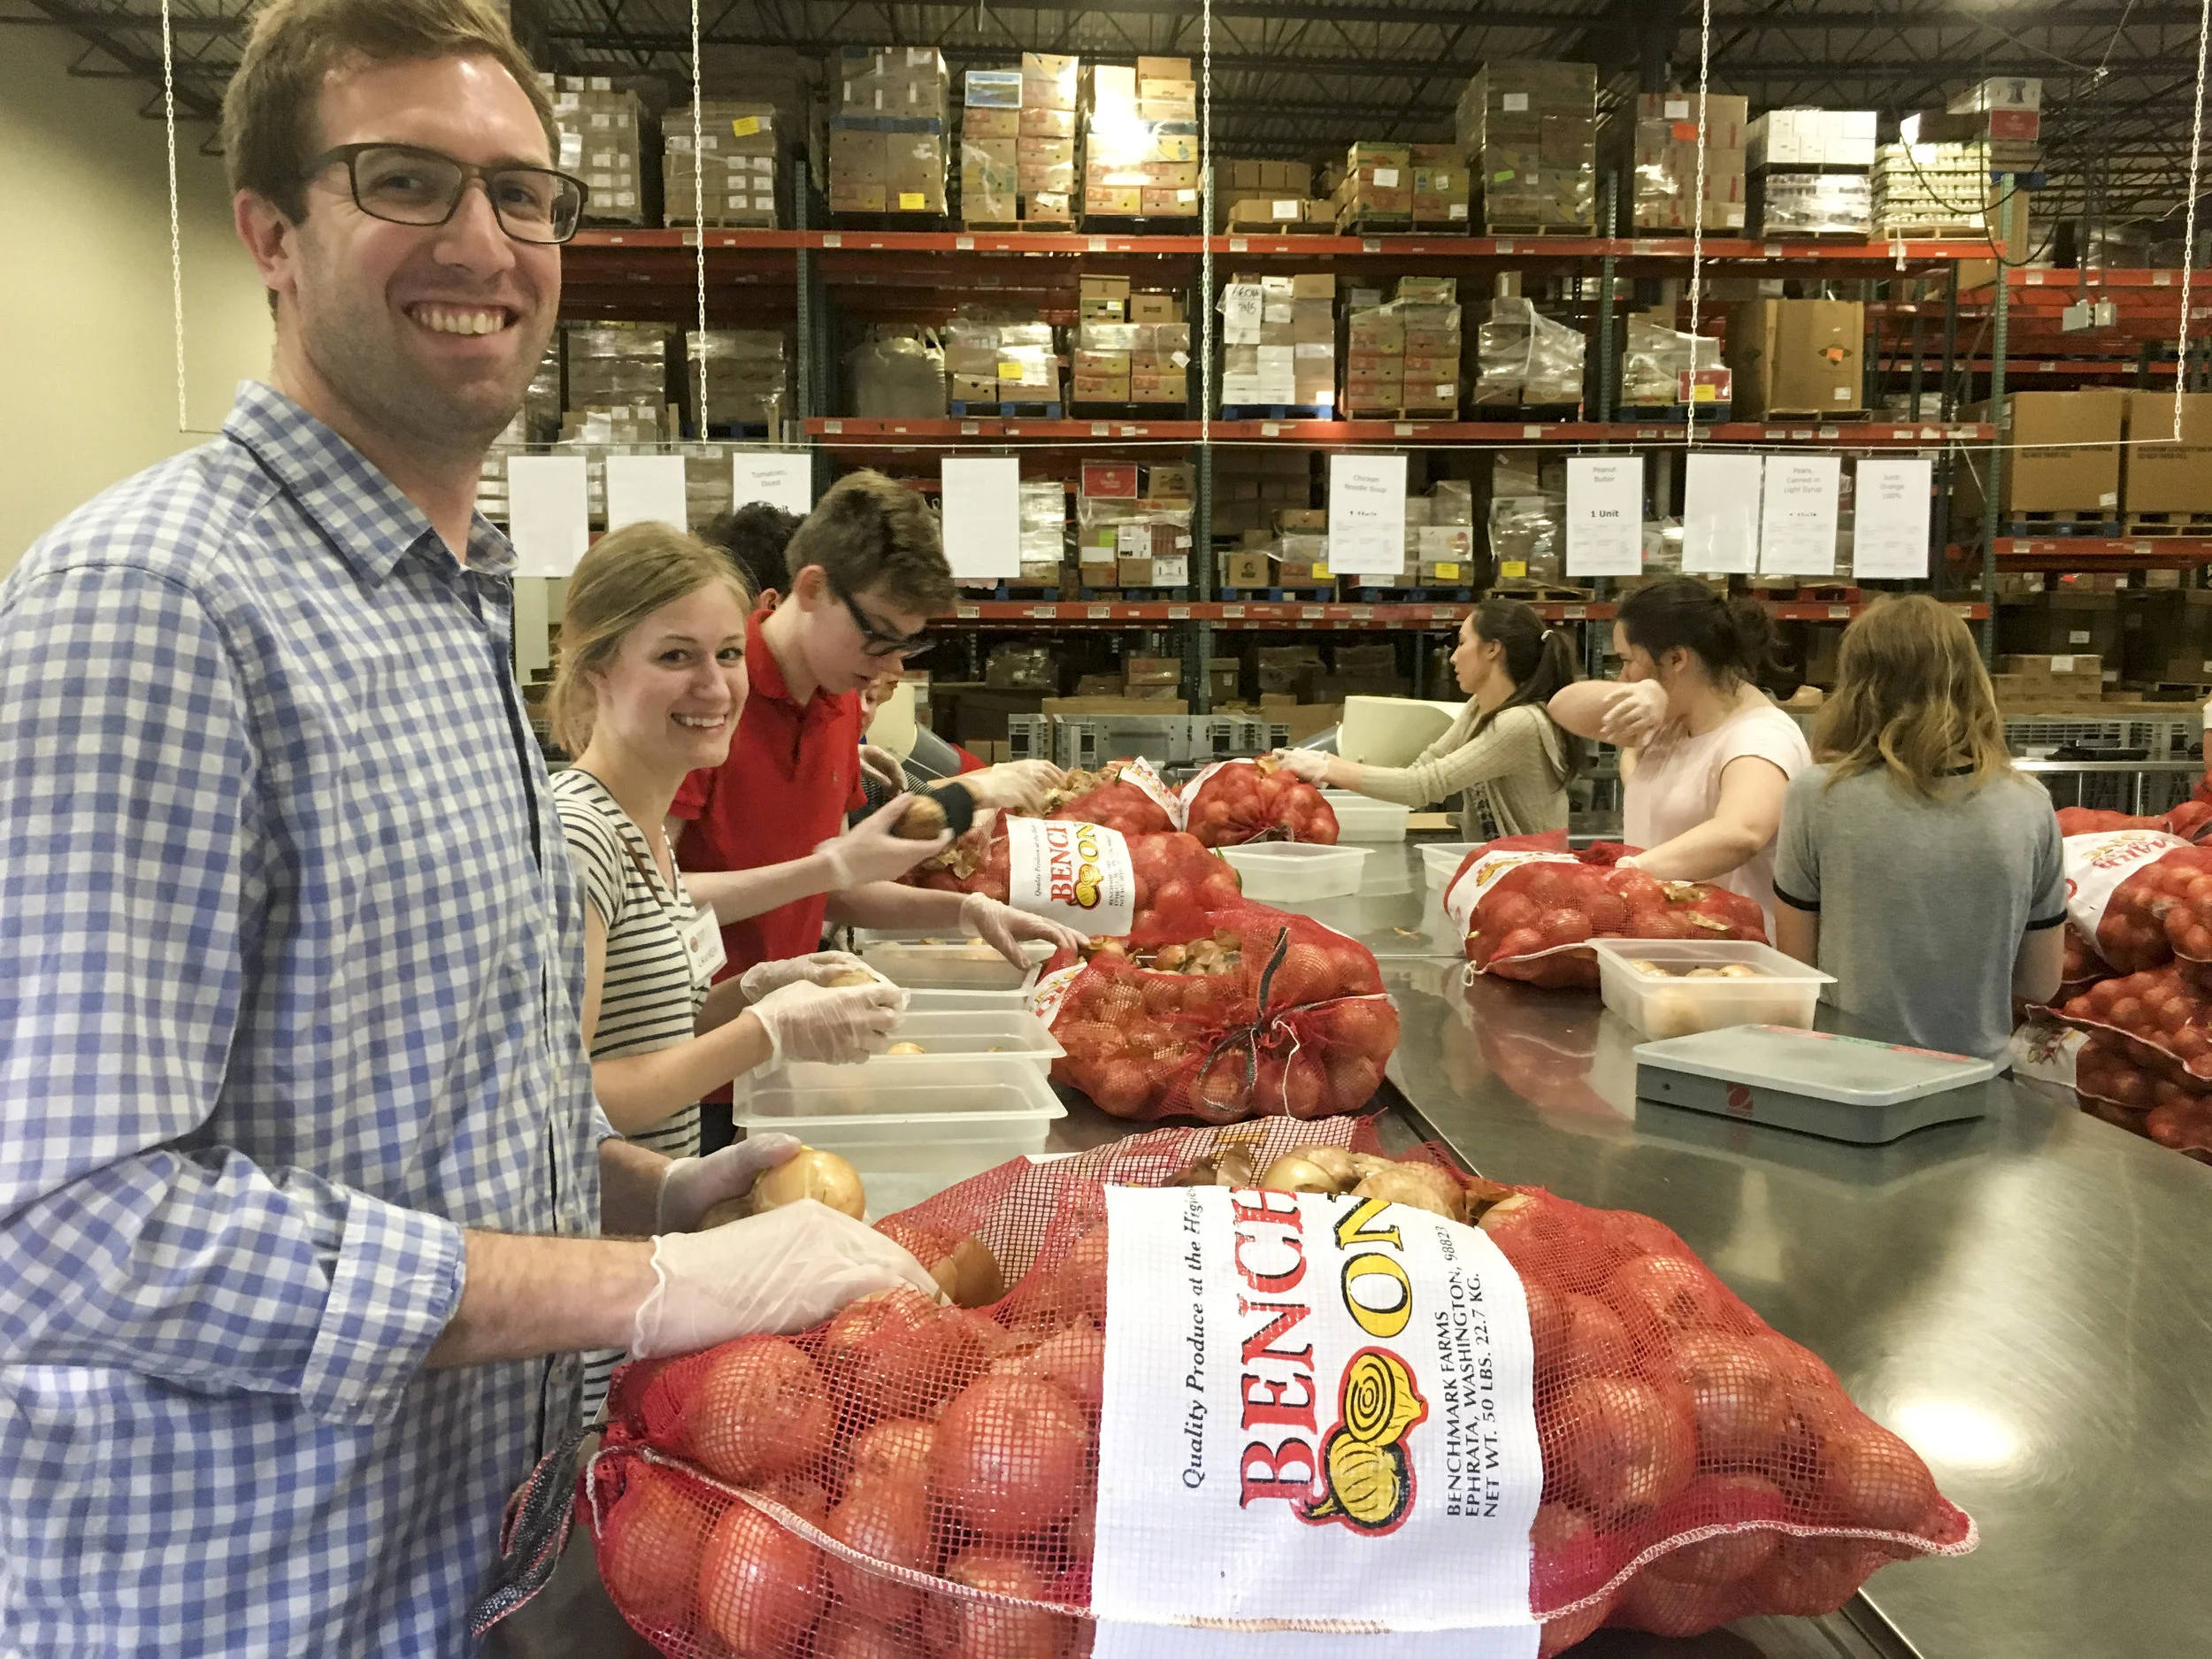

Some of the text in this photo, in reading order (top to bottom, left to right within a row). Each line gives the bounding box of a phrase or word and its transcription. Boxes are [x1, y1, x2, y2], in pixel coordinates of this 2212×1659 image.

[1369, 485, 1387, 494] Soup
[1183, 1240, 1202, 1271] the
[1187, 1277, 1203, 1296] at
[1185, 1302, 1205, 1393] Produce
[1434, 1224, 1481, 1517] EPHRATA, WASHINGTON, 98823
[1433, 1310, 1463, 1516] BENCHMARK FARMS
[1466, 1271, 1500, 1517] NET WT. 50 LBS. 22.7 KG.
[1181, 1398, 1208, 1488] Quality
